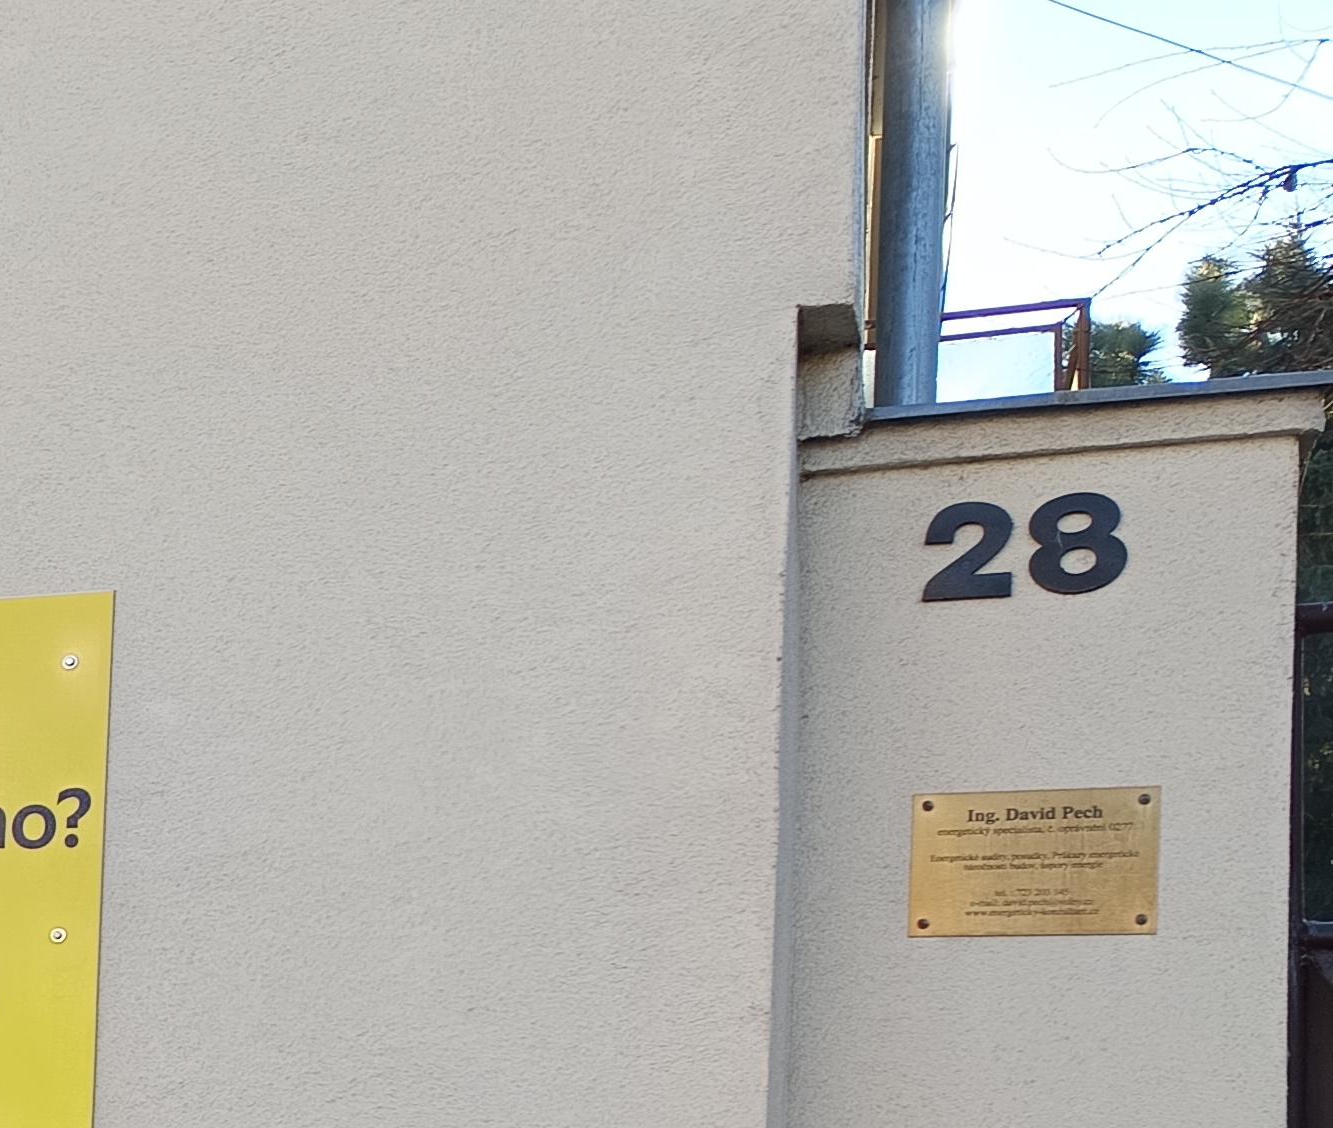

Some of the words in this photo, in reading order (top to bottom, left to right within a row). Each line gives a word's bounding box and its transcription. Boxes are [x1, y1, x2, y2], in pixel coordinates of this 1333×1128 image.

[922, 492, 1128, 603] 28
[966, 809, 1000, 824] Ing.
[1006, 806, 1056, 821] David
[1061, 805, 1104, 819] Pech
